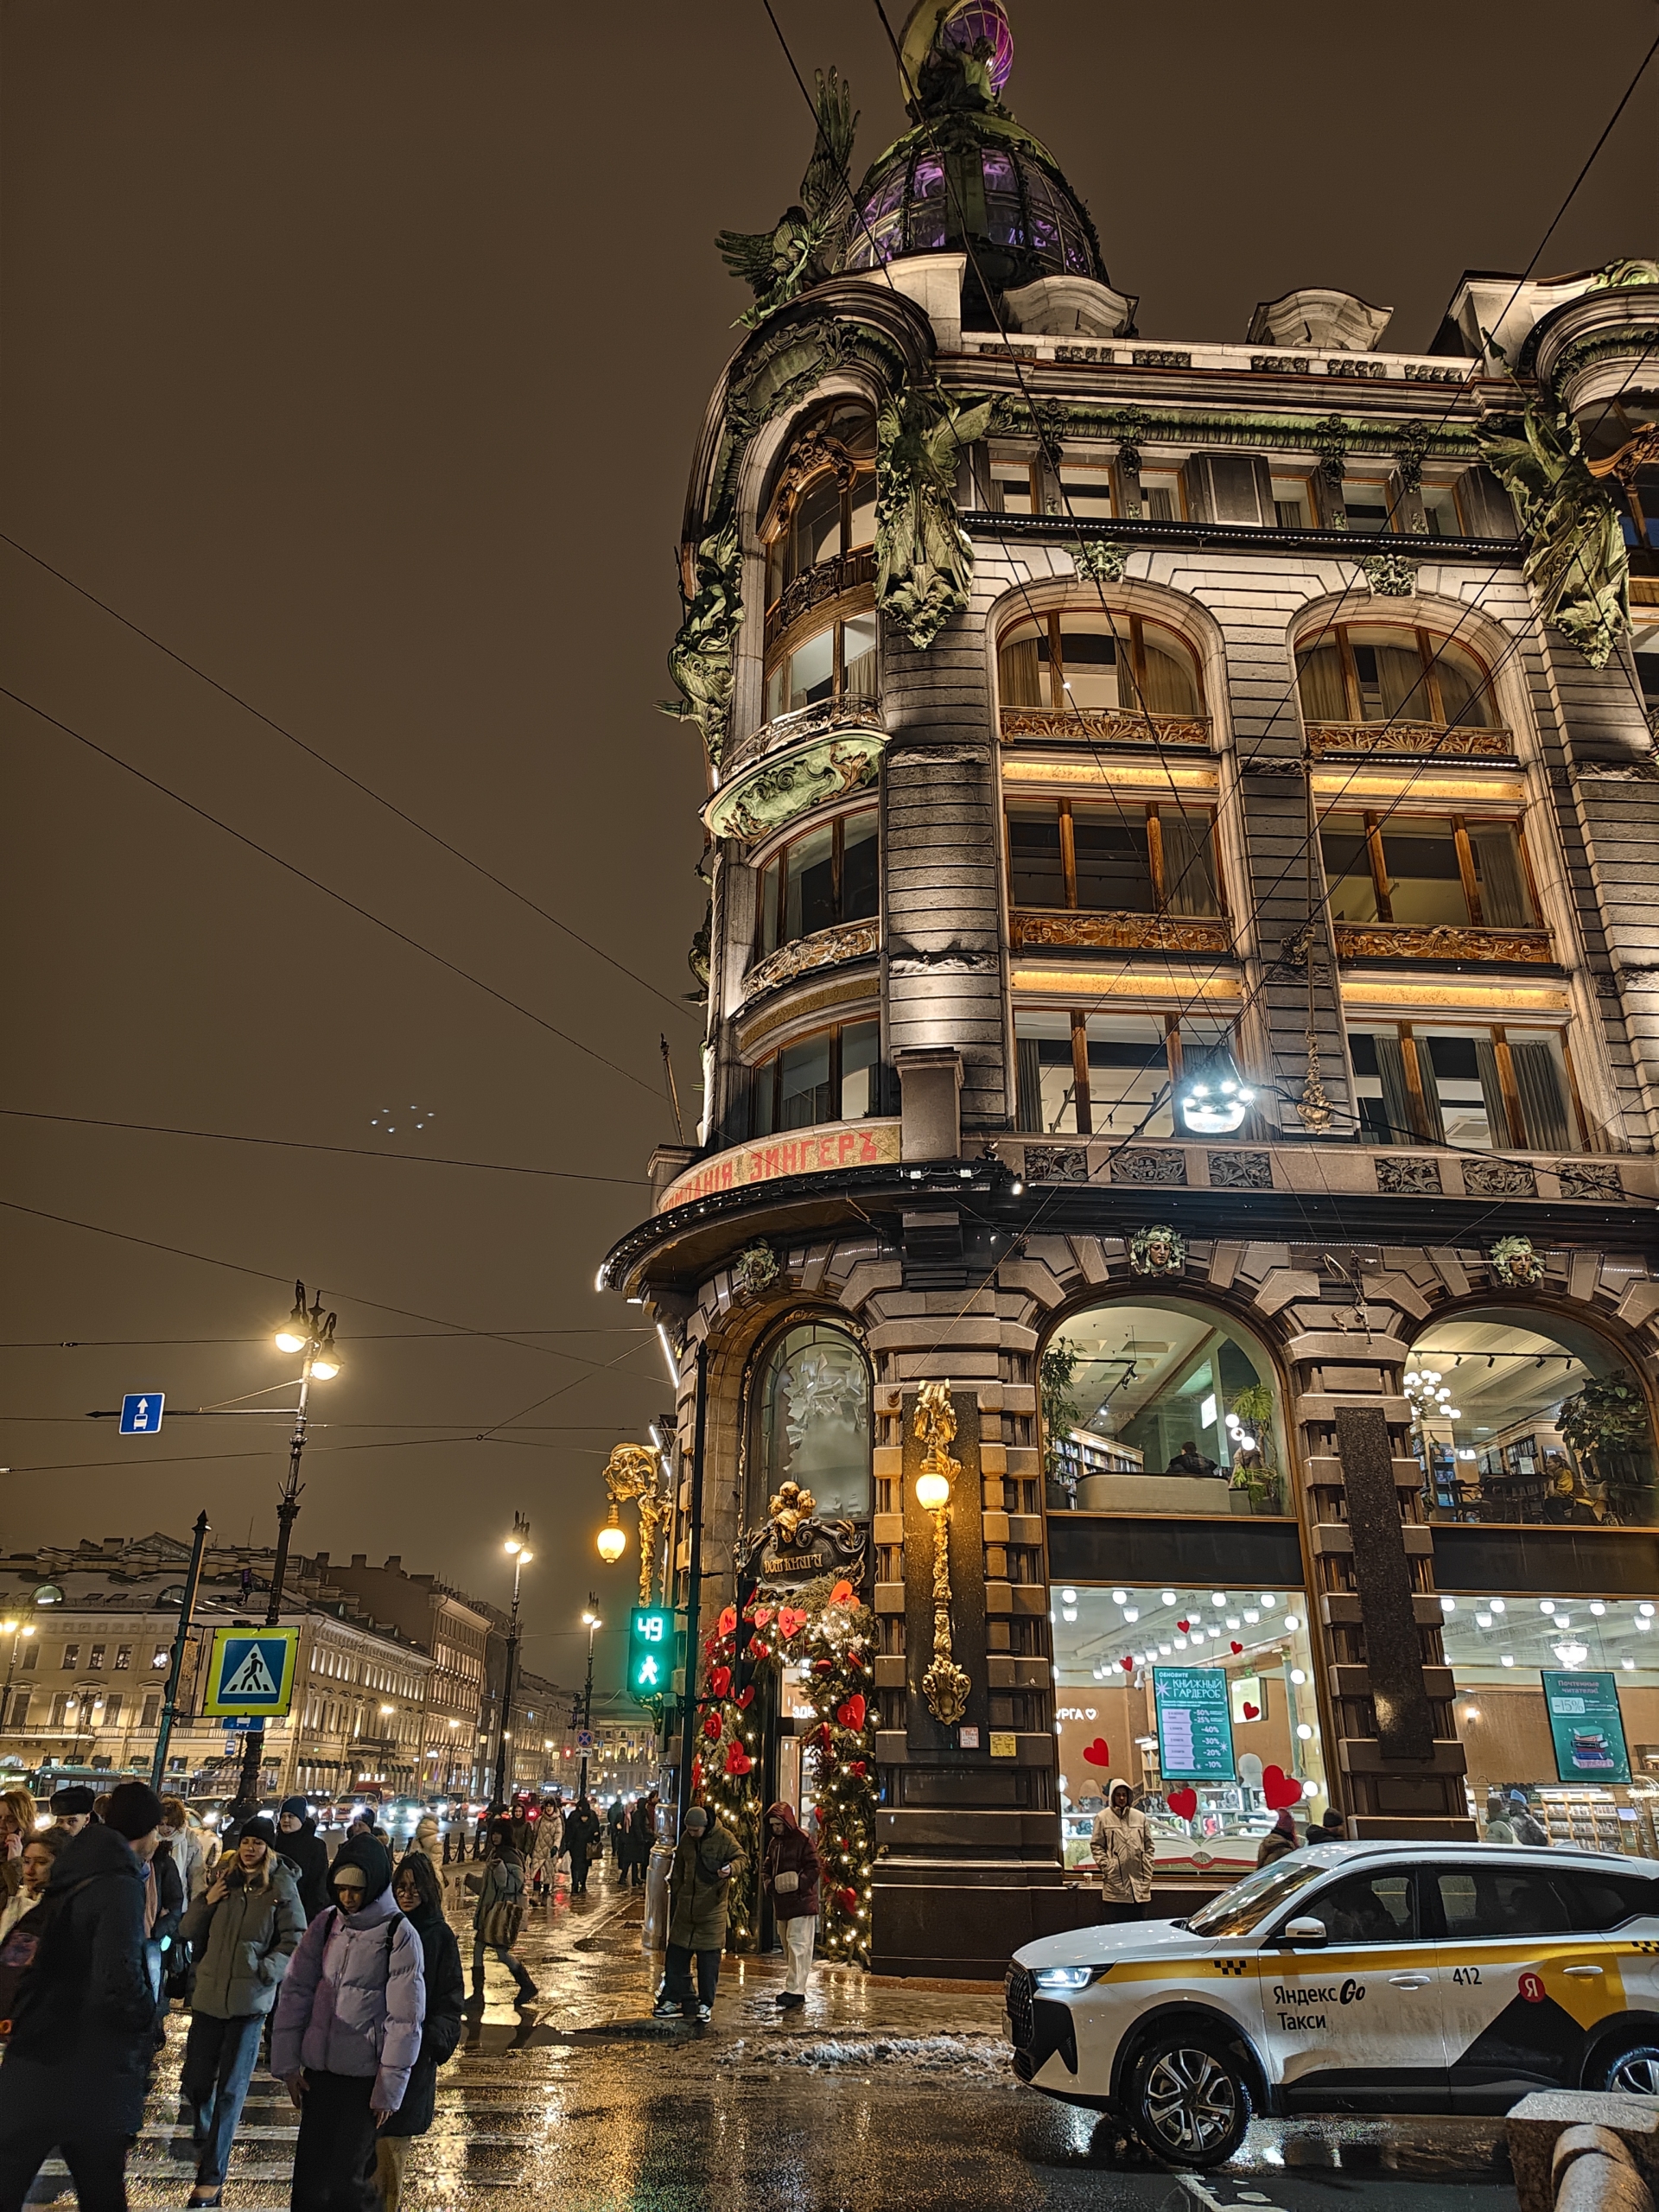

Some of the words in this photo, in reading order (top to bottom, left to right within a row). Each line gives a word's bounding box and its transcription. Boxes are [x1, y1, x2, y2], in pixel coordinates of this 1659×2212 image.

[750, 1132, 877, 1182] ЗИНГЕРЪ
[638, 1617, 664, 1642] 49
[1173, 1679, 1223, 1689] КНИЖНЫЙ
[1173, 1688, 1221, 1699] ГАРДЕРОБ
[1554, 1700, 1584, 1712] -15%
[1452, 1967, 1482, 1986] 412
[1273, 1986, 1338, 2006] Яндекс
[1339, 1979, 1366, 2005] Go
[1524, 1978, 1538, 1997] Я
[1277, 2012, 1326, 2031] Такси
